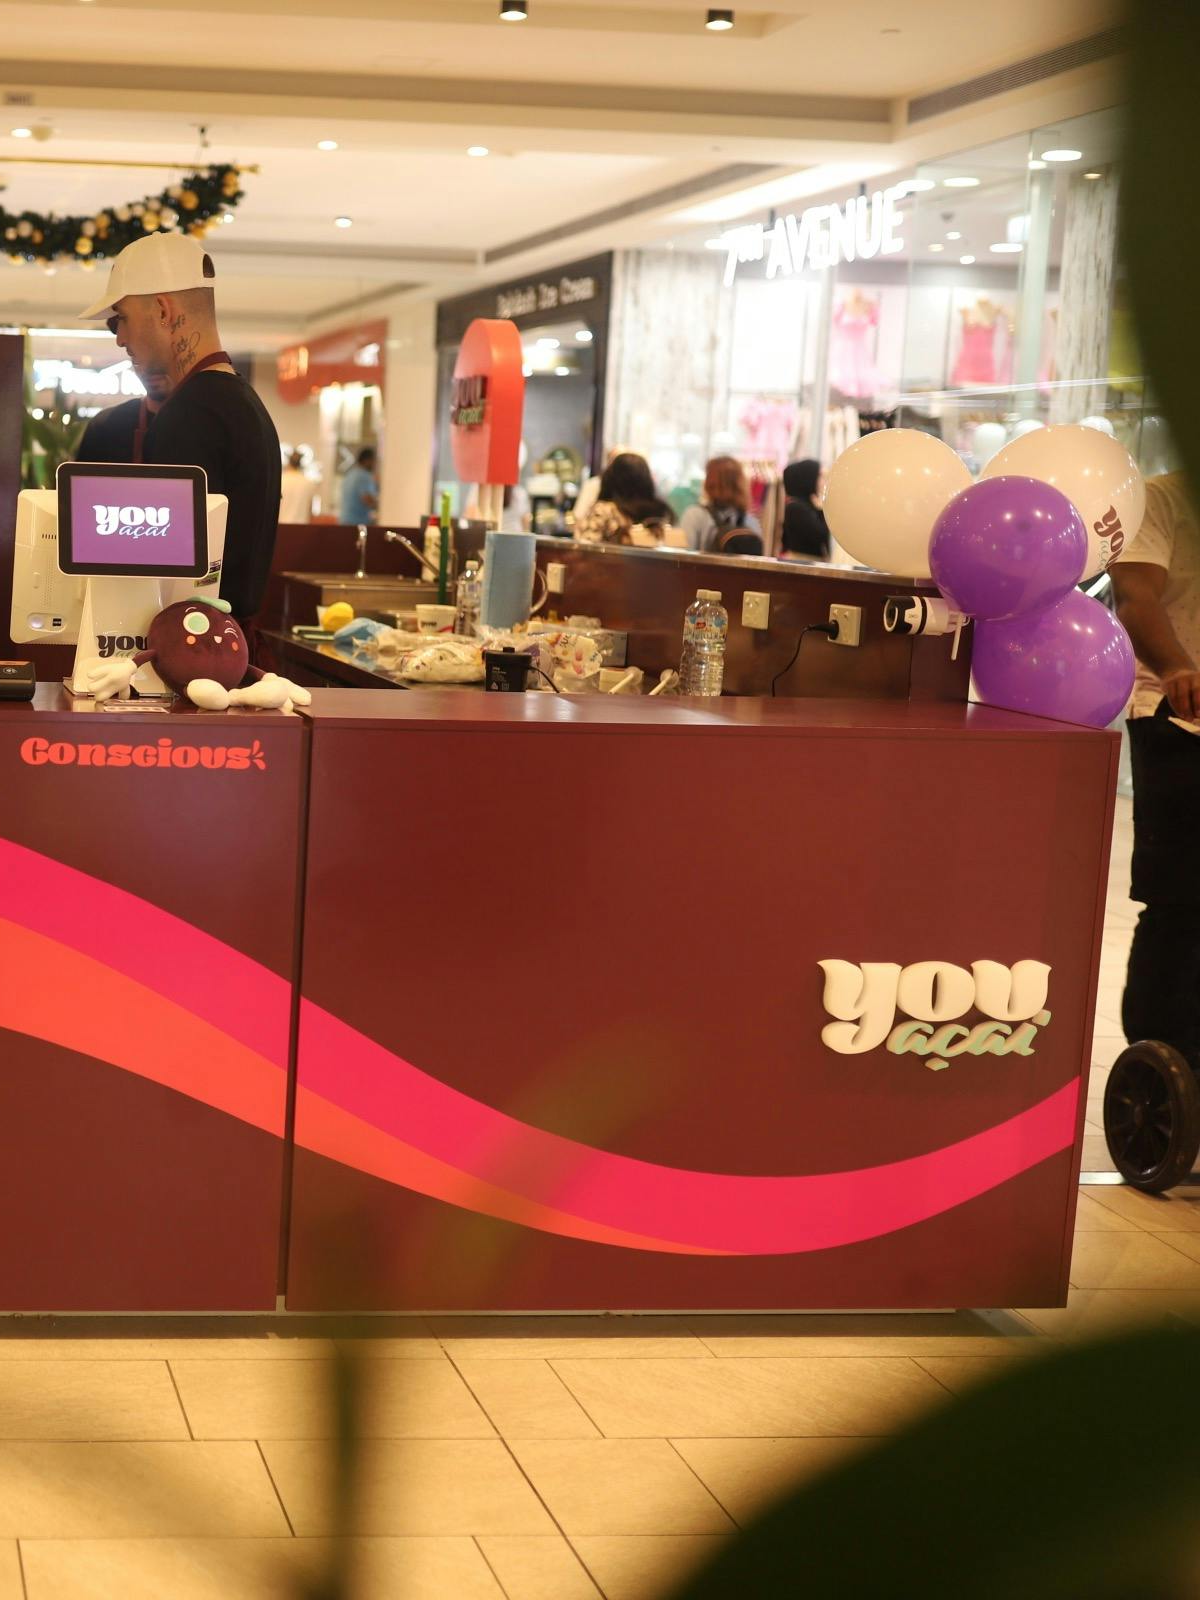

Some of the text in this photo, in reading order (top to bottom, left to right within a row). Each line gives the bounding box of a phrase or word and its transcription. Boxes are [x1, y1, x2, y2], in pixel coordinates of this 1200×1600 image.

[766, 185, 905, 279] AVENUE
[92, 505, 170, 535] you
[96, 635, 148, 658] you
[20, 737, 252, 770] Conscious
[817, 959, 1052, 1054] you
